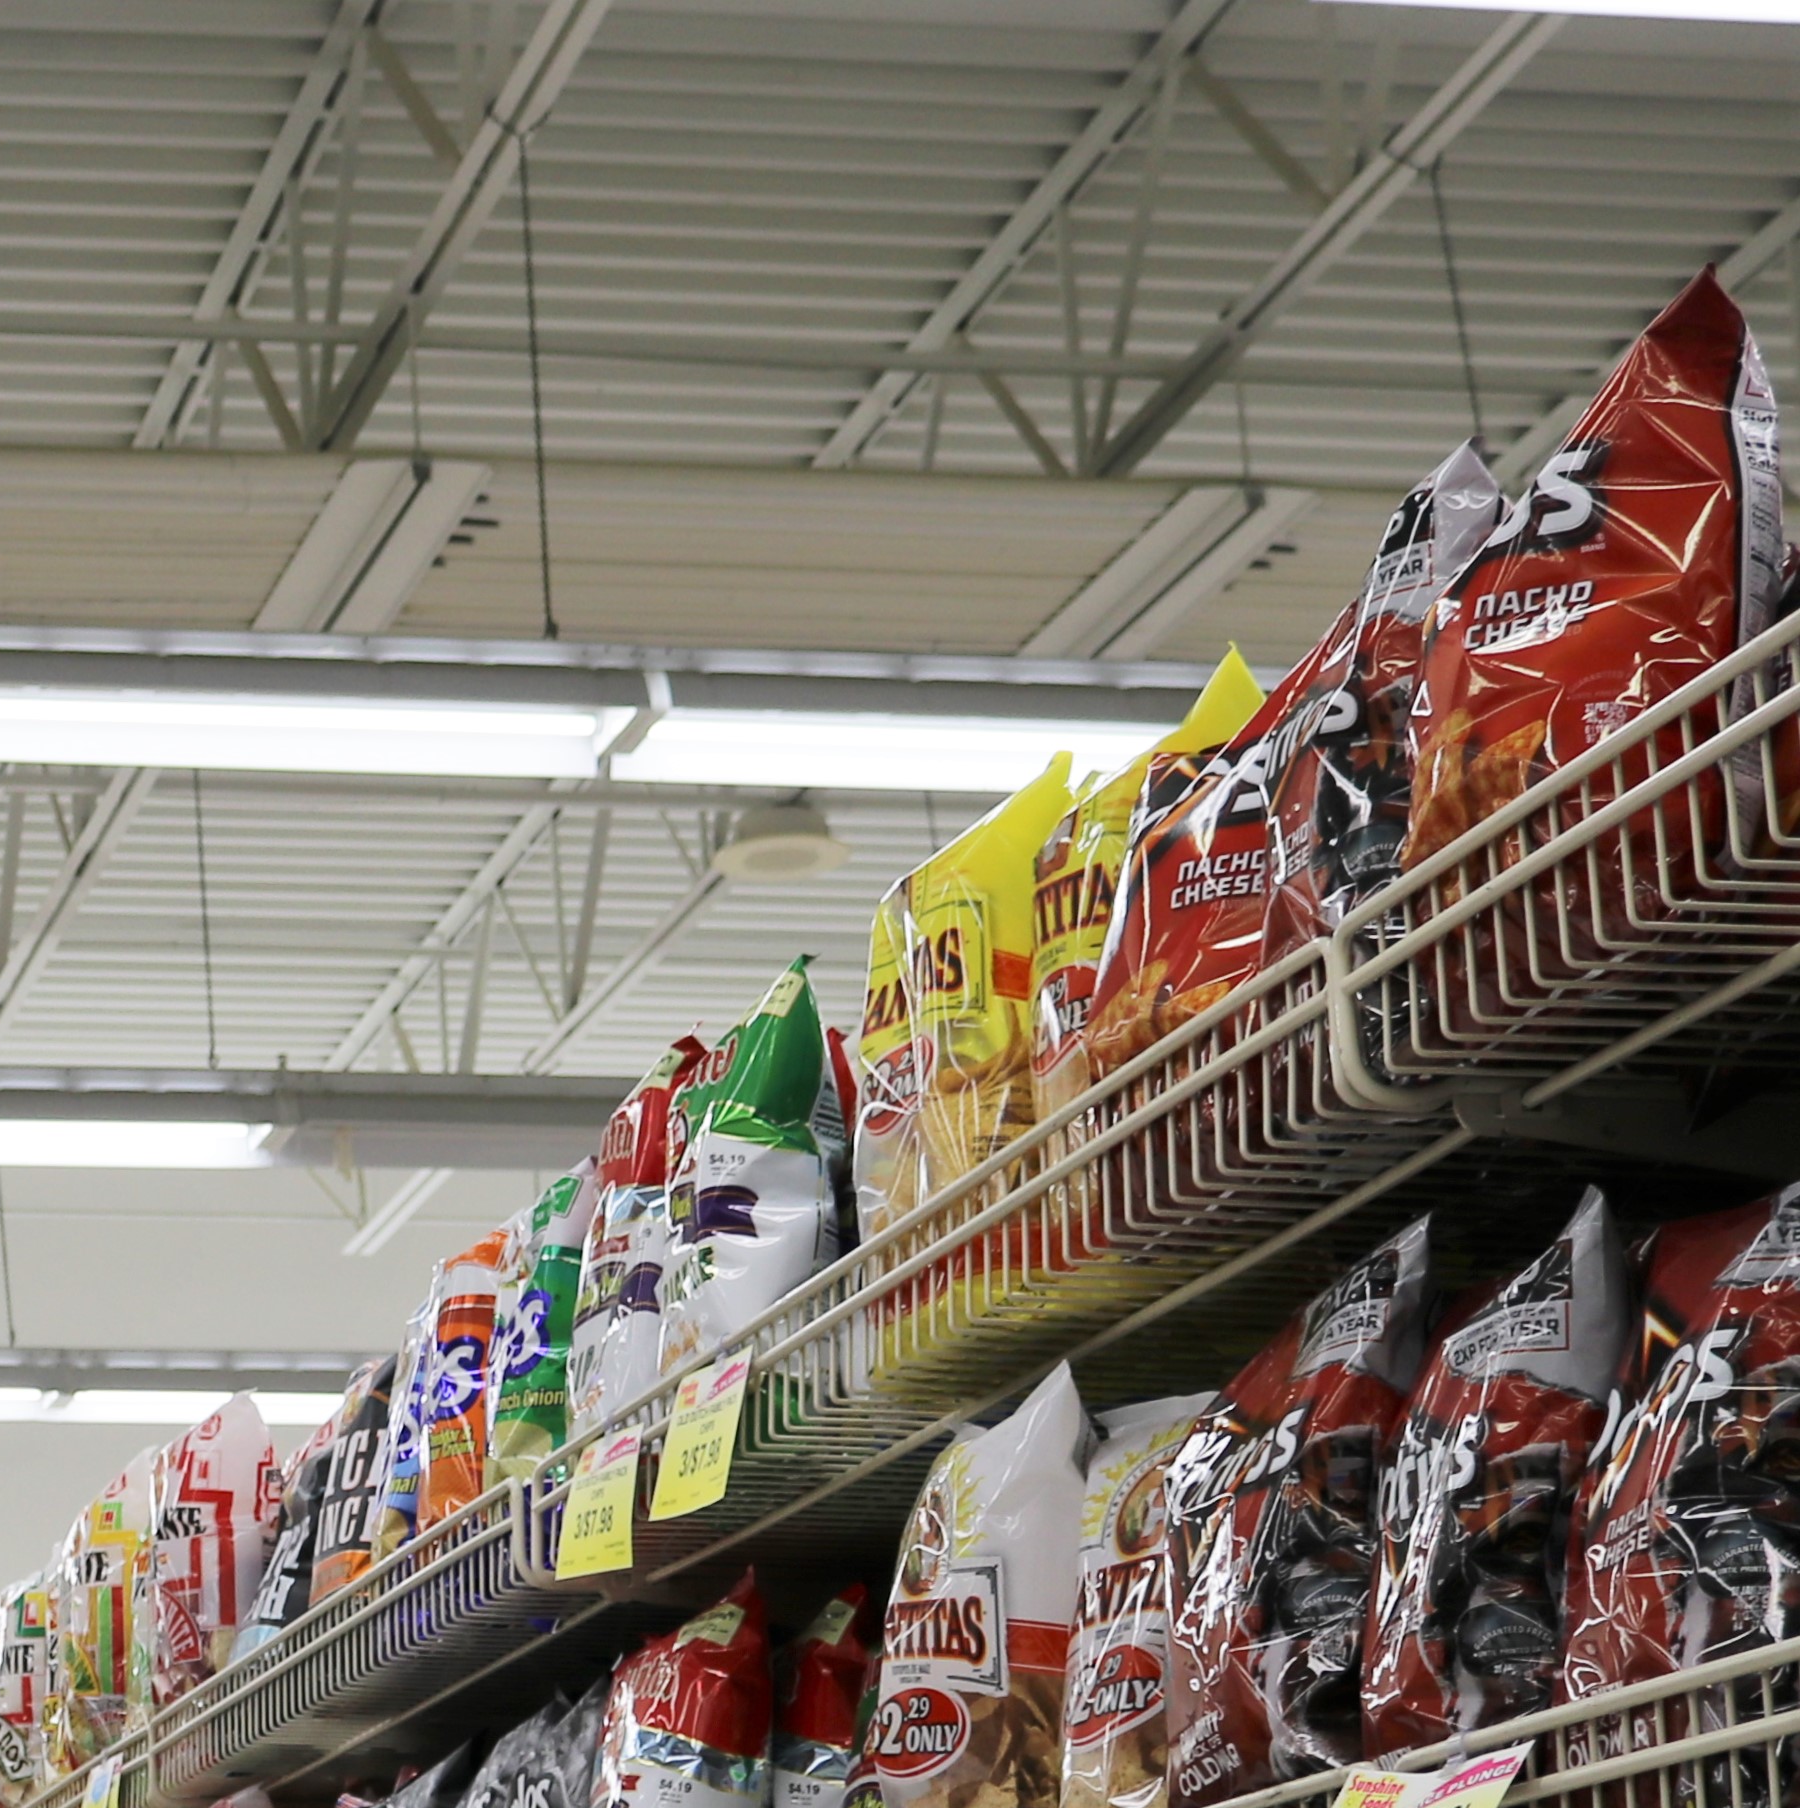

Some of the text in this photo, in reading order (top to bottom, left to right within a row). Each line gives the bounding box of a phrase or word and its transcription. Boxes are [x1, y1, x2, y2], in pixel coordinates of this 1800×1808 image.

[1474, 581, 1593, 620] NACHO
[1338, 1314, 1378, 1335] YEAR
[678, 1437, 723, 1478] 3/$7.98
[575, 1505, 613, 1539] 3/$7.98
[1095, 1677, 1156, 1715] ONLY
[905, 1723, 959, 1754] ONLY
[658, 1779, 692, 1793] $4.19
[1350, 1775, 1405, 1795] Sunshine
[1444, 1762, 1519, 1793] PLUNGE
